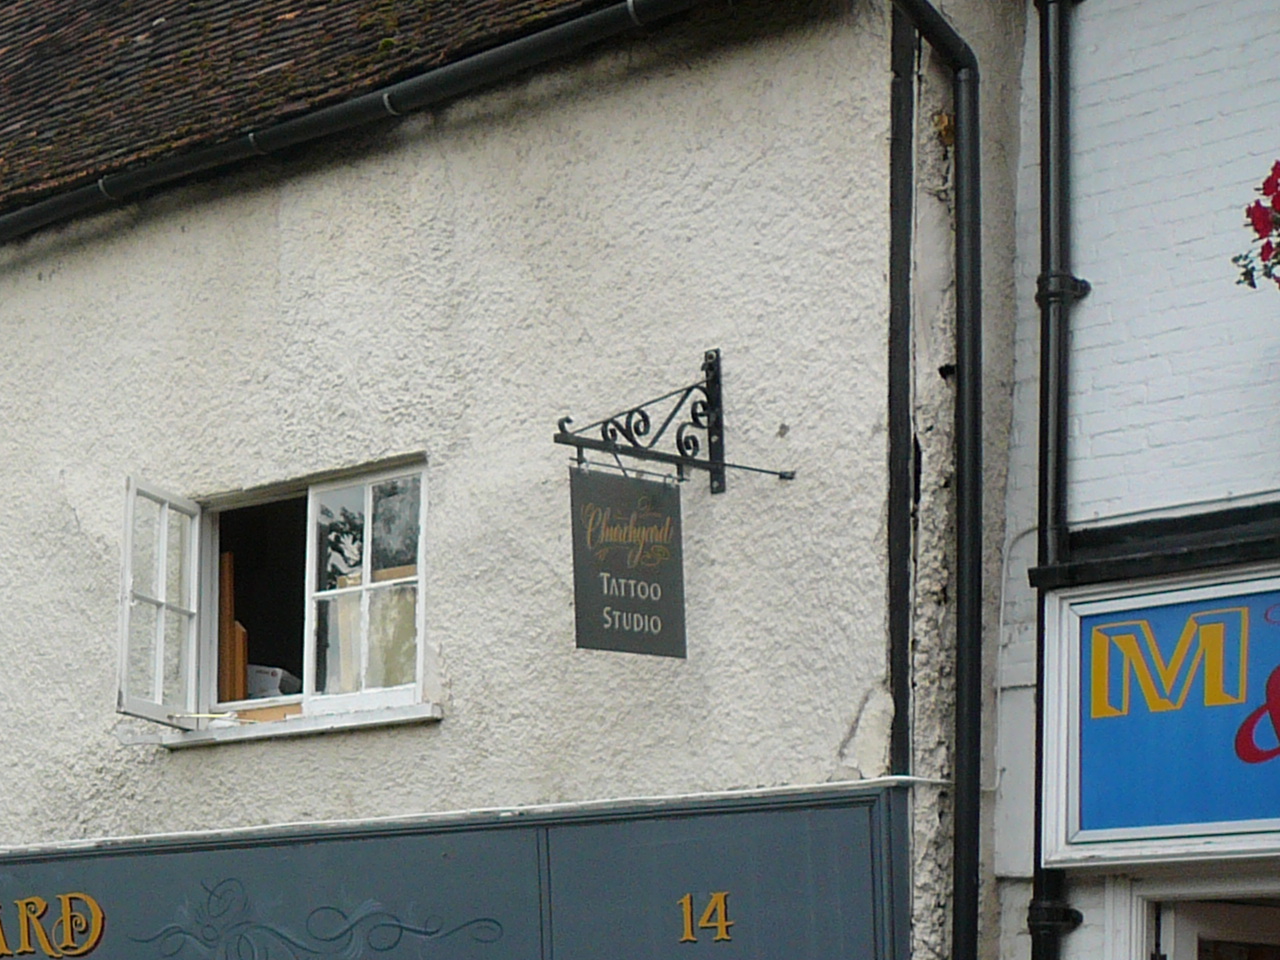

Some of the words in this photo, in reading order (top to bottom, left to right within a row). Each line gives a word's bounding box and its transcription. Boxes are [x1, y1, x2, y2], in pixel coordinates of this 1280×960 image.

[600, 572, 662, 601] TATTOO
[603, 606, 662, 634] STUDIO
[676, 890, 735, 942] 14
